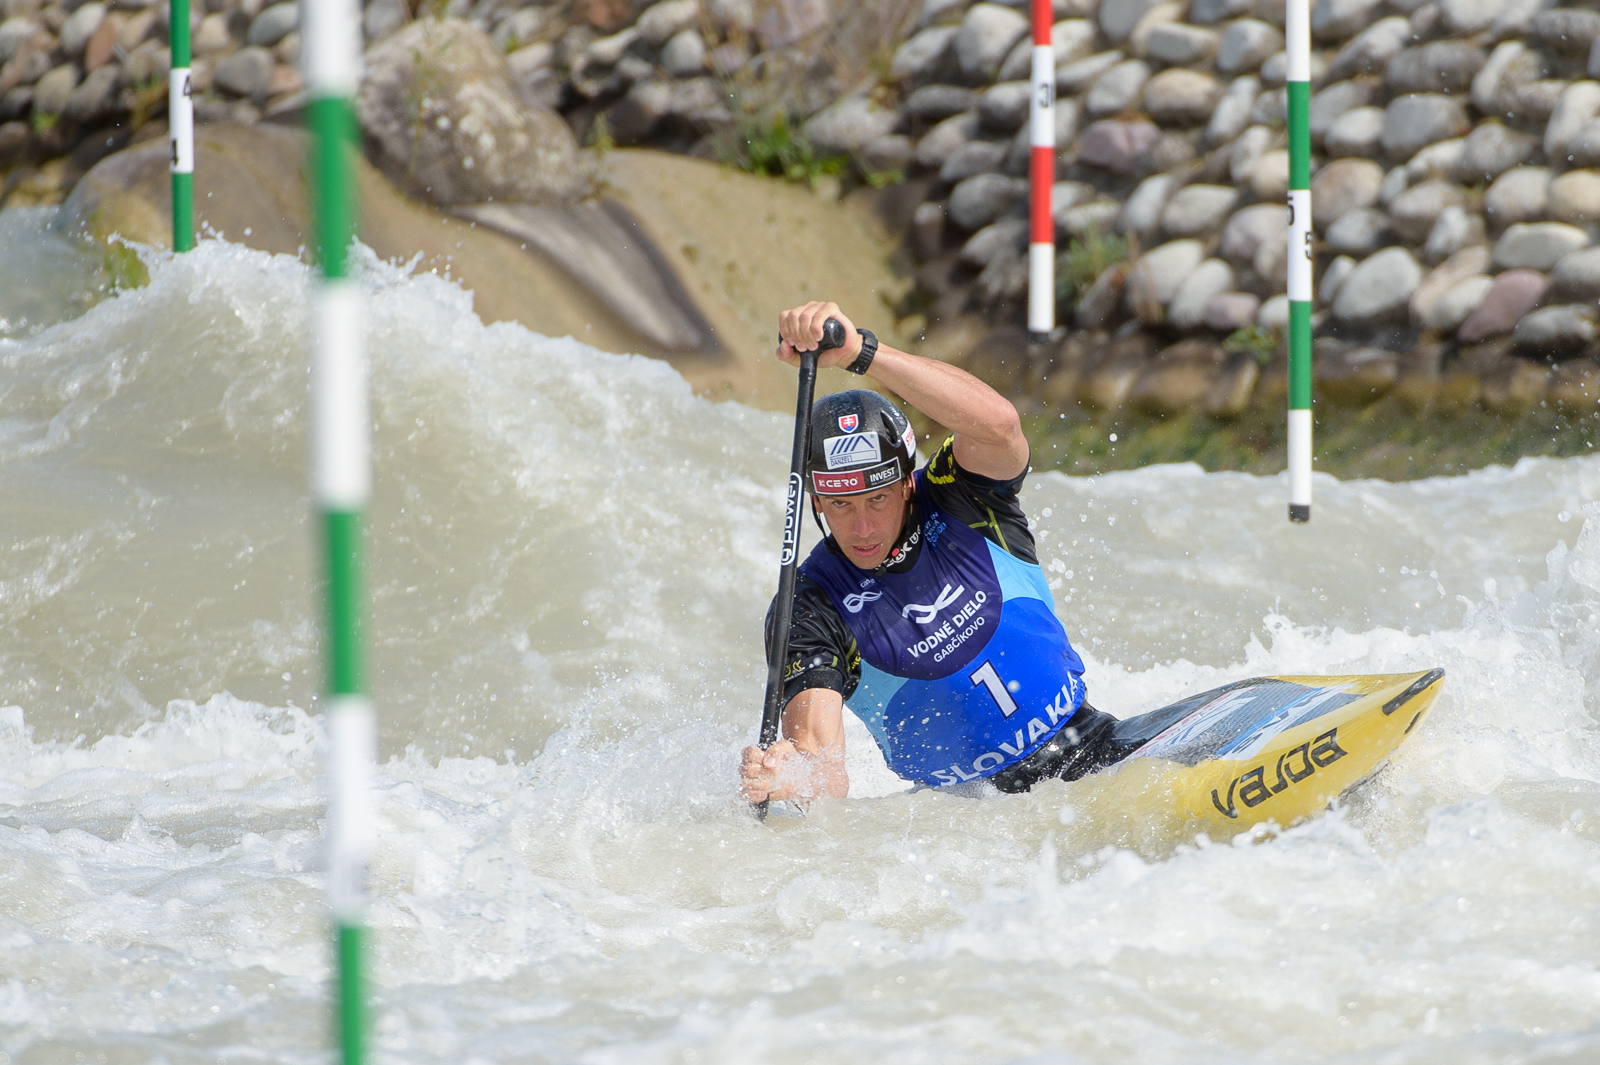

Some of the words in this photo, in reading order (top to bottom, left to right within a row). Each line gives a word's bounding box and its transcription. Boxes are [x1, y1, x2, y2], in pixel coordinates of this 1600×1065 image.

[869, 467, 896, 482] INVEST
[907, 620, 956, 658] VODNÉ
[951, 590, 987, 628] DIELO
[933, 616, 985, 662] GABČÍKOVO
[968, 658, 1019, 720] 1
[930, 671, 1078, 787] SLOVAKIA
